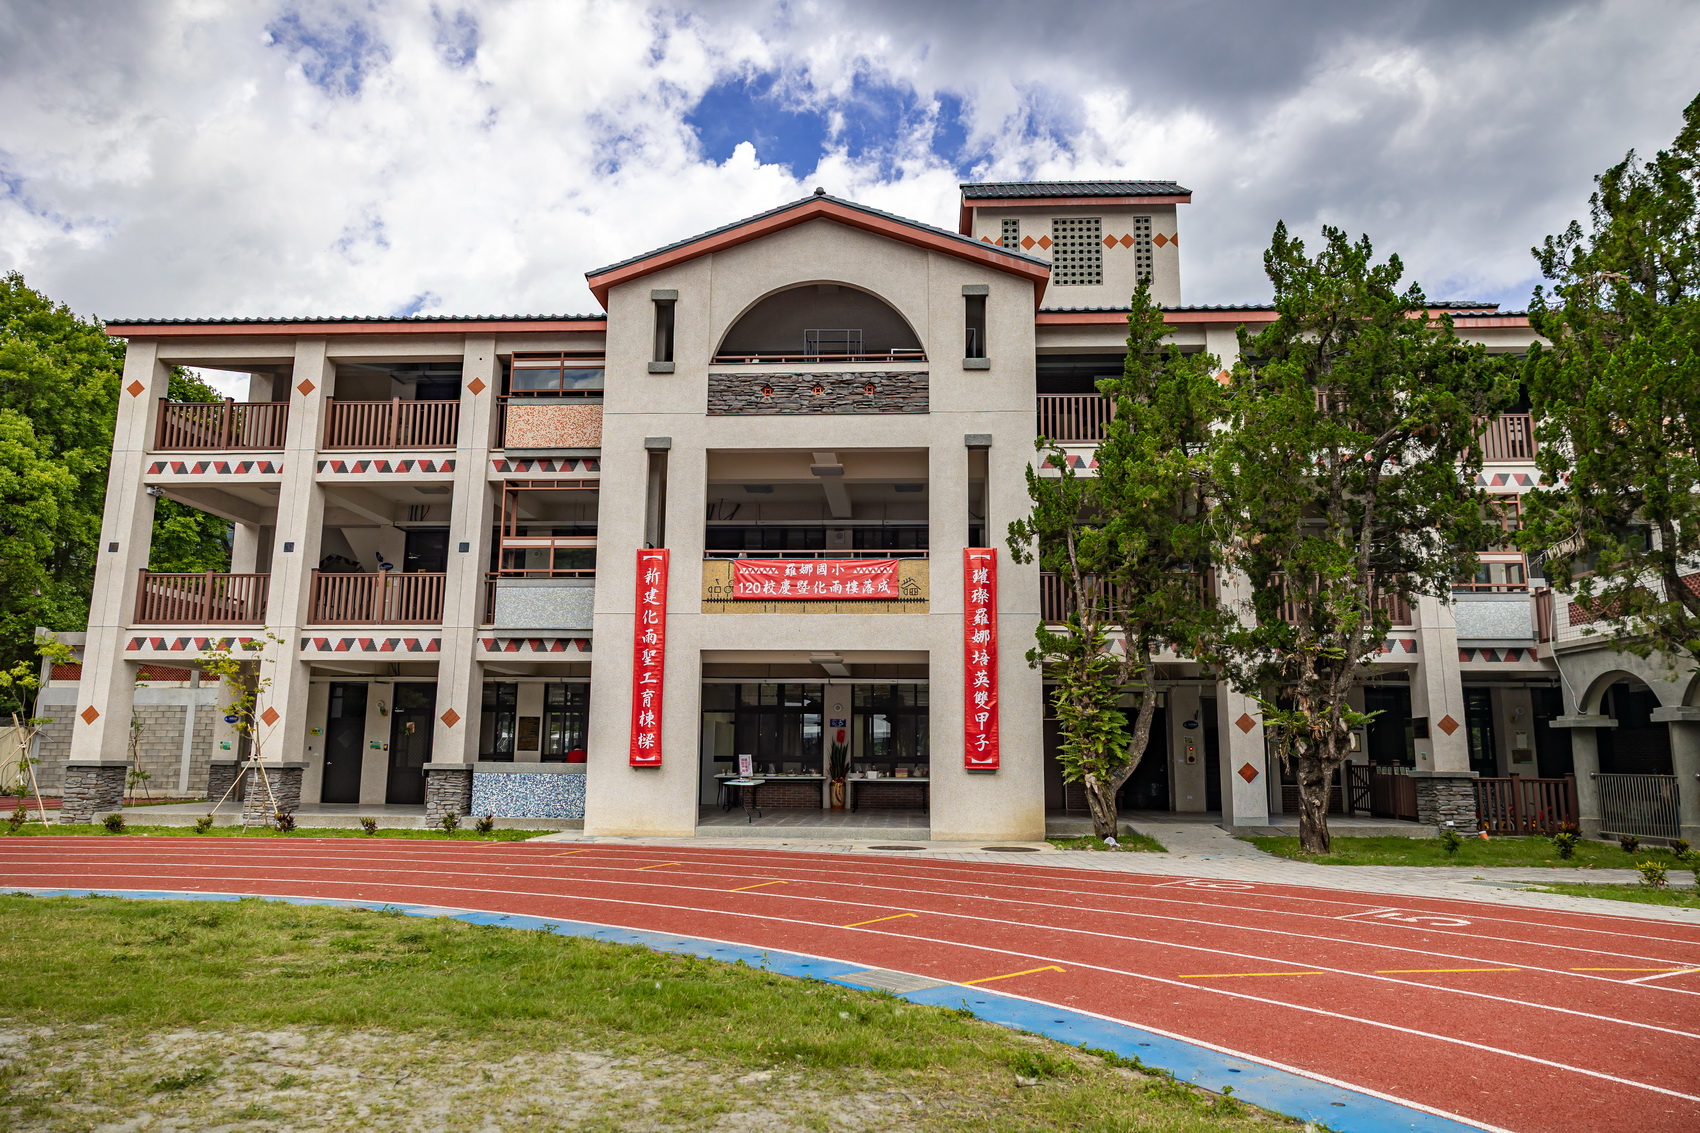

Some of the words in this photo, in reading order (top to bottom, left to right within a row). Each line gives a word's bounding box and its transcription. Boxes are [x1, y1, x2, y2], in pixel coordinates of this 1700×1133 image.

[783, 563, 845, 577] 羅娜國小
[738, 578, 891, 595] 120校慶暨化雨樓落成
